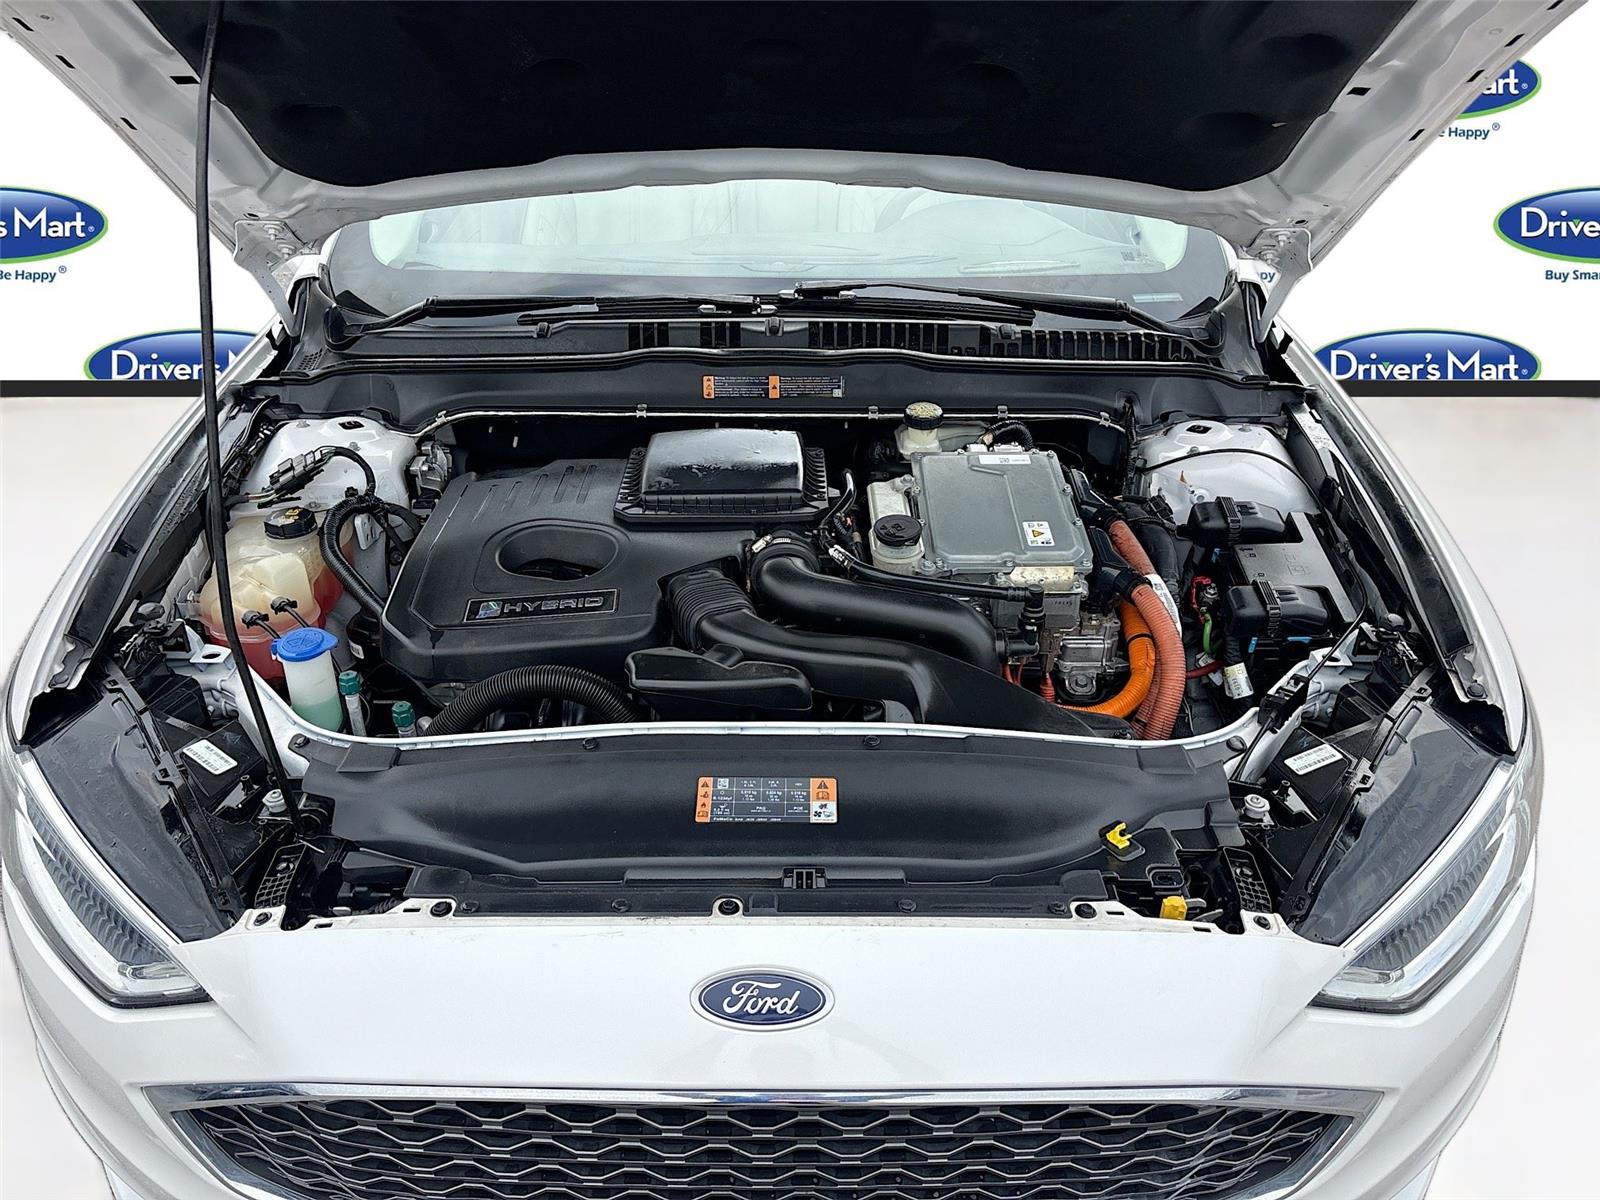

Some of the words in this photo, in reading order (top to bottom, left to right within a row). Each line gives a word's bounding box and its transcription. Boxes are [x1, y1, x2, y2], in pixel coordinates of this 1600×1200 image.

[1448, 127, 1490, 140] Happy
[14, 206, 86, 238] Mart
[14, 270, 57, 283] Happy
[1545, 269, 1570, 283] Buy
[1572, 269, 1600, 280] Sma
[1330, 349, 1441, 380] Driver's
[1447, 349, 1519, 380] Mart
[503, 596, 604, 613] HYBRID
[722, 980, 801, 1015] Ford
